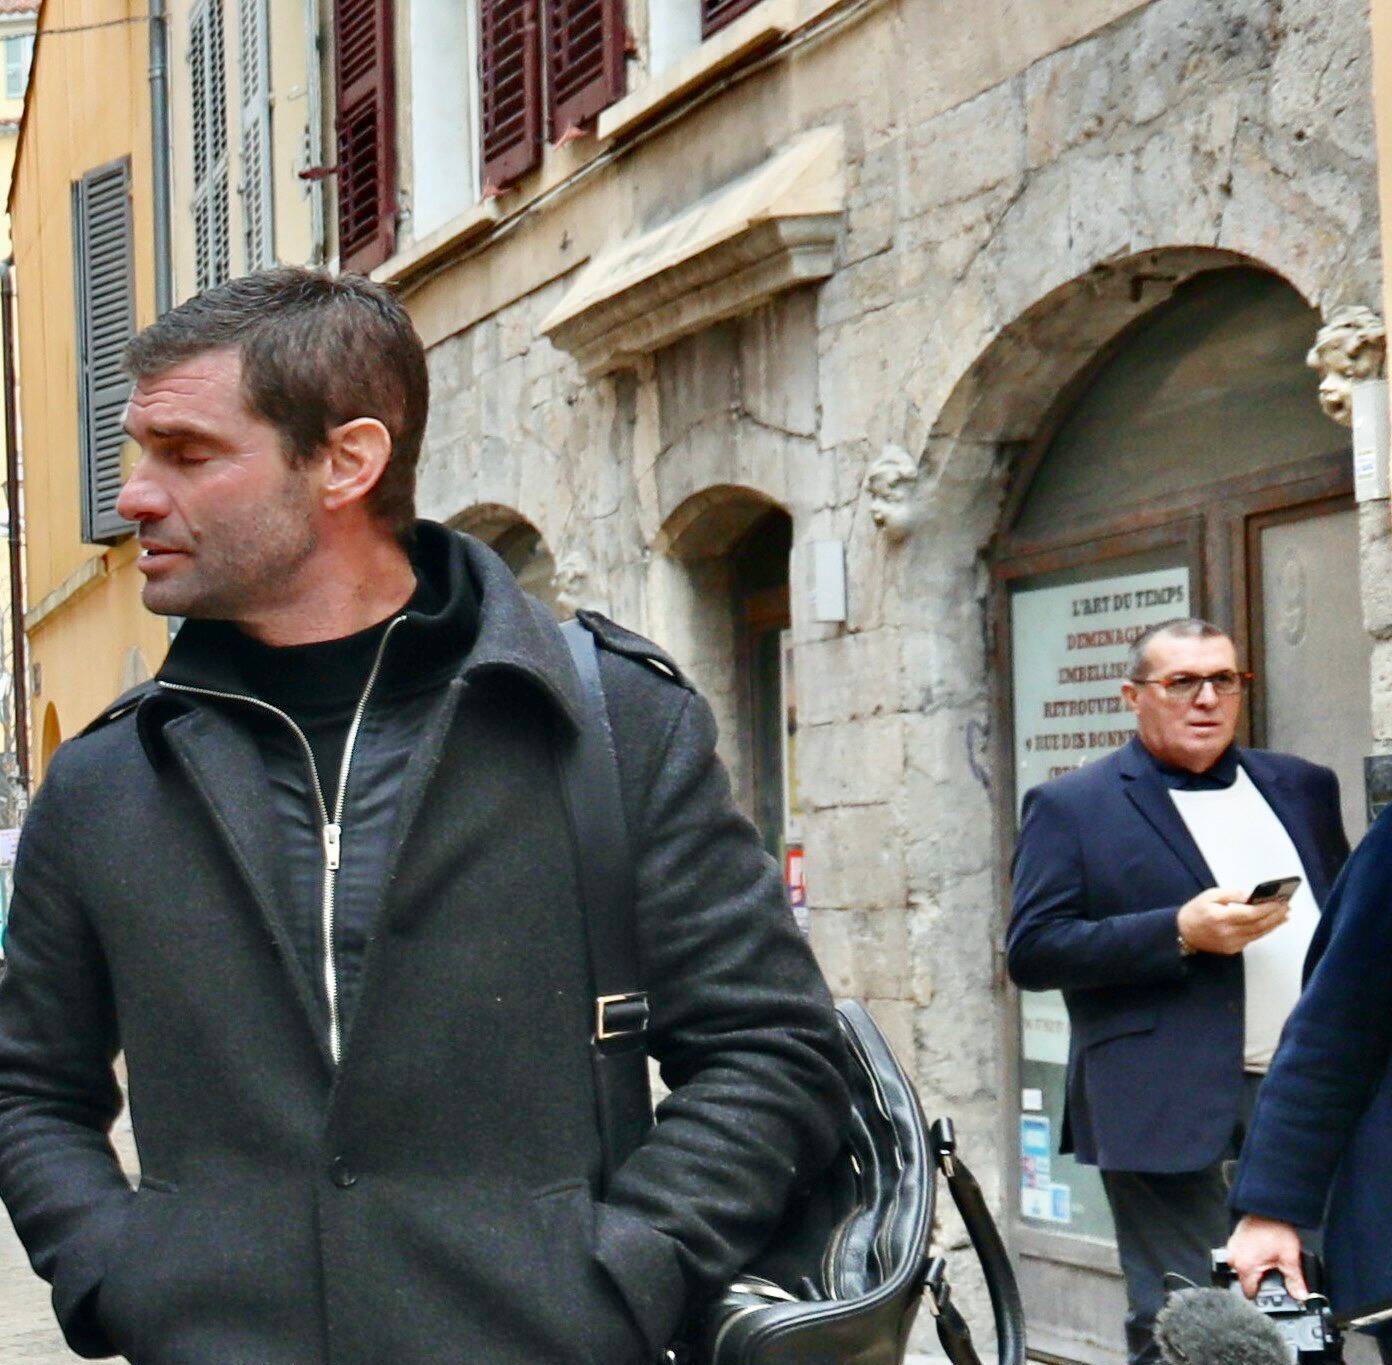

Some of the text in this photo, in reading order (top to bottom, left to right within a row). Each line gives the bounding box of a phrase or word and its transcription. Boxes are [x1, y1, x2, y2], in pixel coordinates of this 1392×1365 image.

[1113, 592, 1132, 612] DU
[1135, 585, 1184, 607] TEMPS
[1062, 732, 1086, 750] DES
